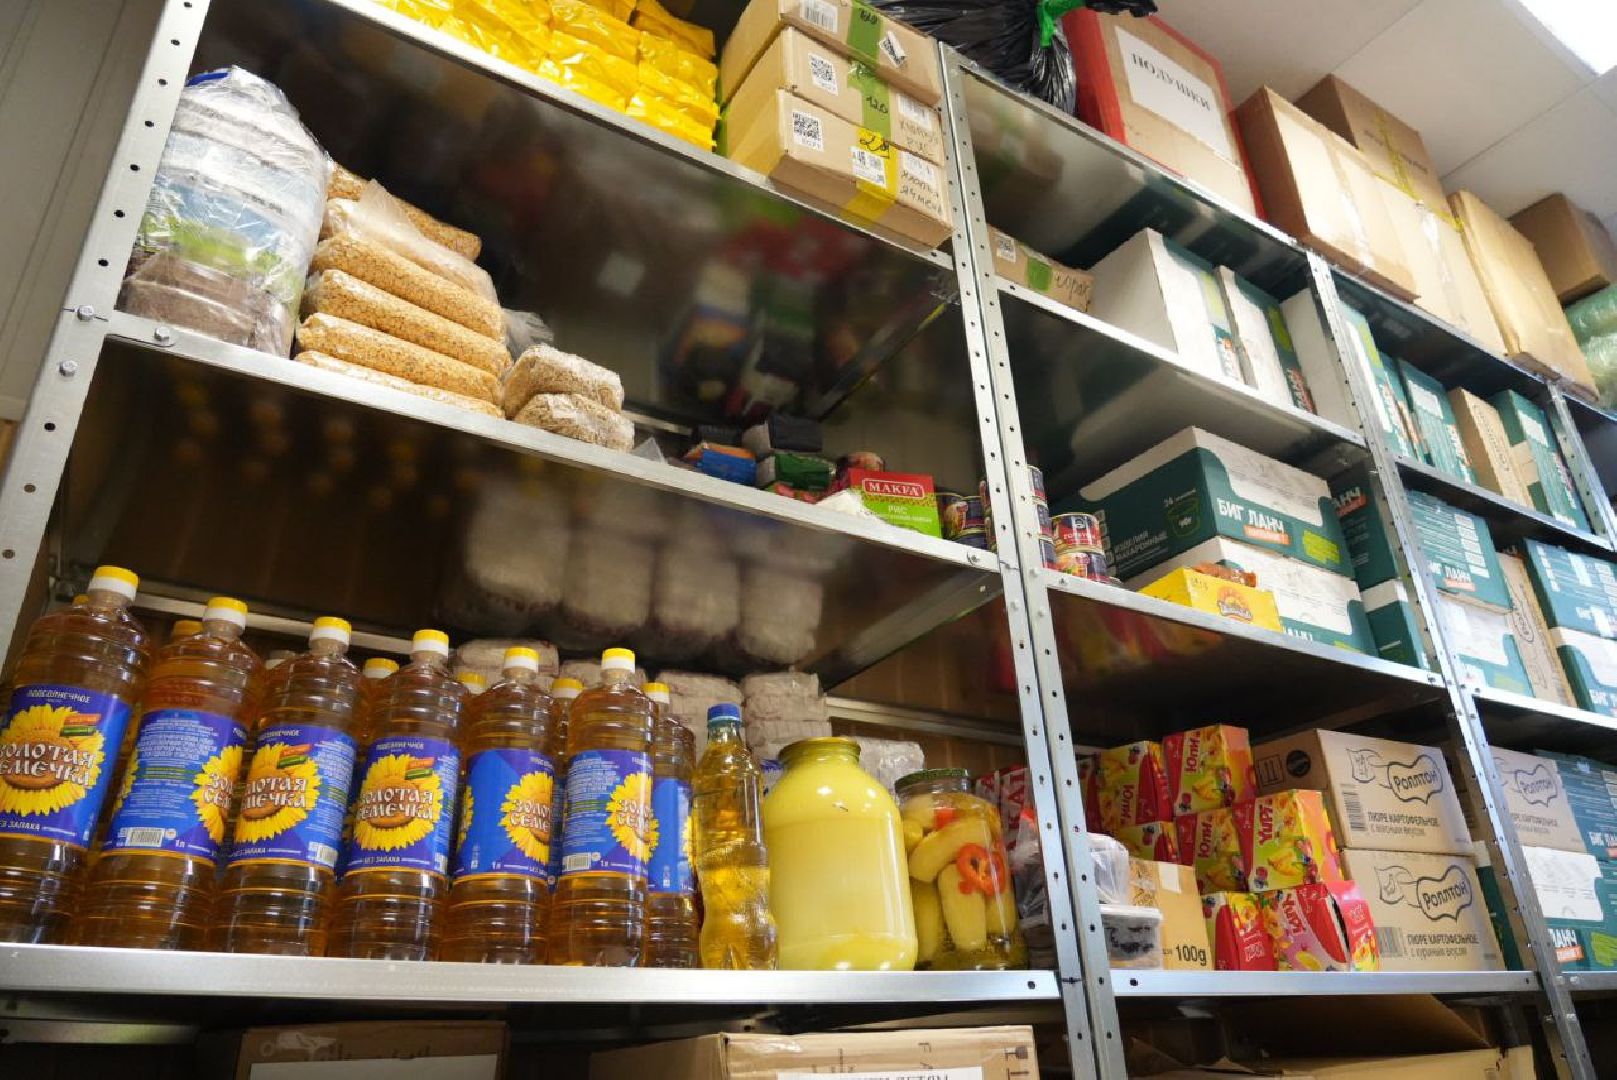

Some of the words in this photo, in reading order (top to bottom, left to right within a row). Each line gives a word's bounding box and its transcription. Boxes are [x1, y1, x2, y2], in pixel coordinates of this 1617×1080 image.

[1216, 497, 1244, 521] БИГ
[1248, 509, 1286, 535] ЛАНЧ
[0, 743, 96, 769] ОЛОТАЯ
[0, 759, 90, 786] ЕМЕЧКА
[1175, 943, 1208, 966] 100g
